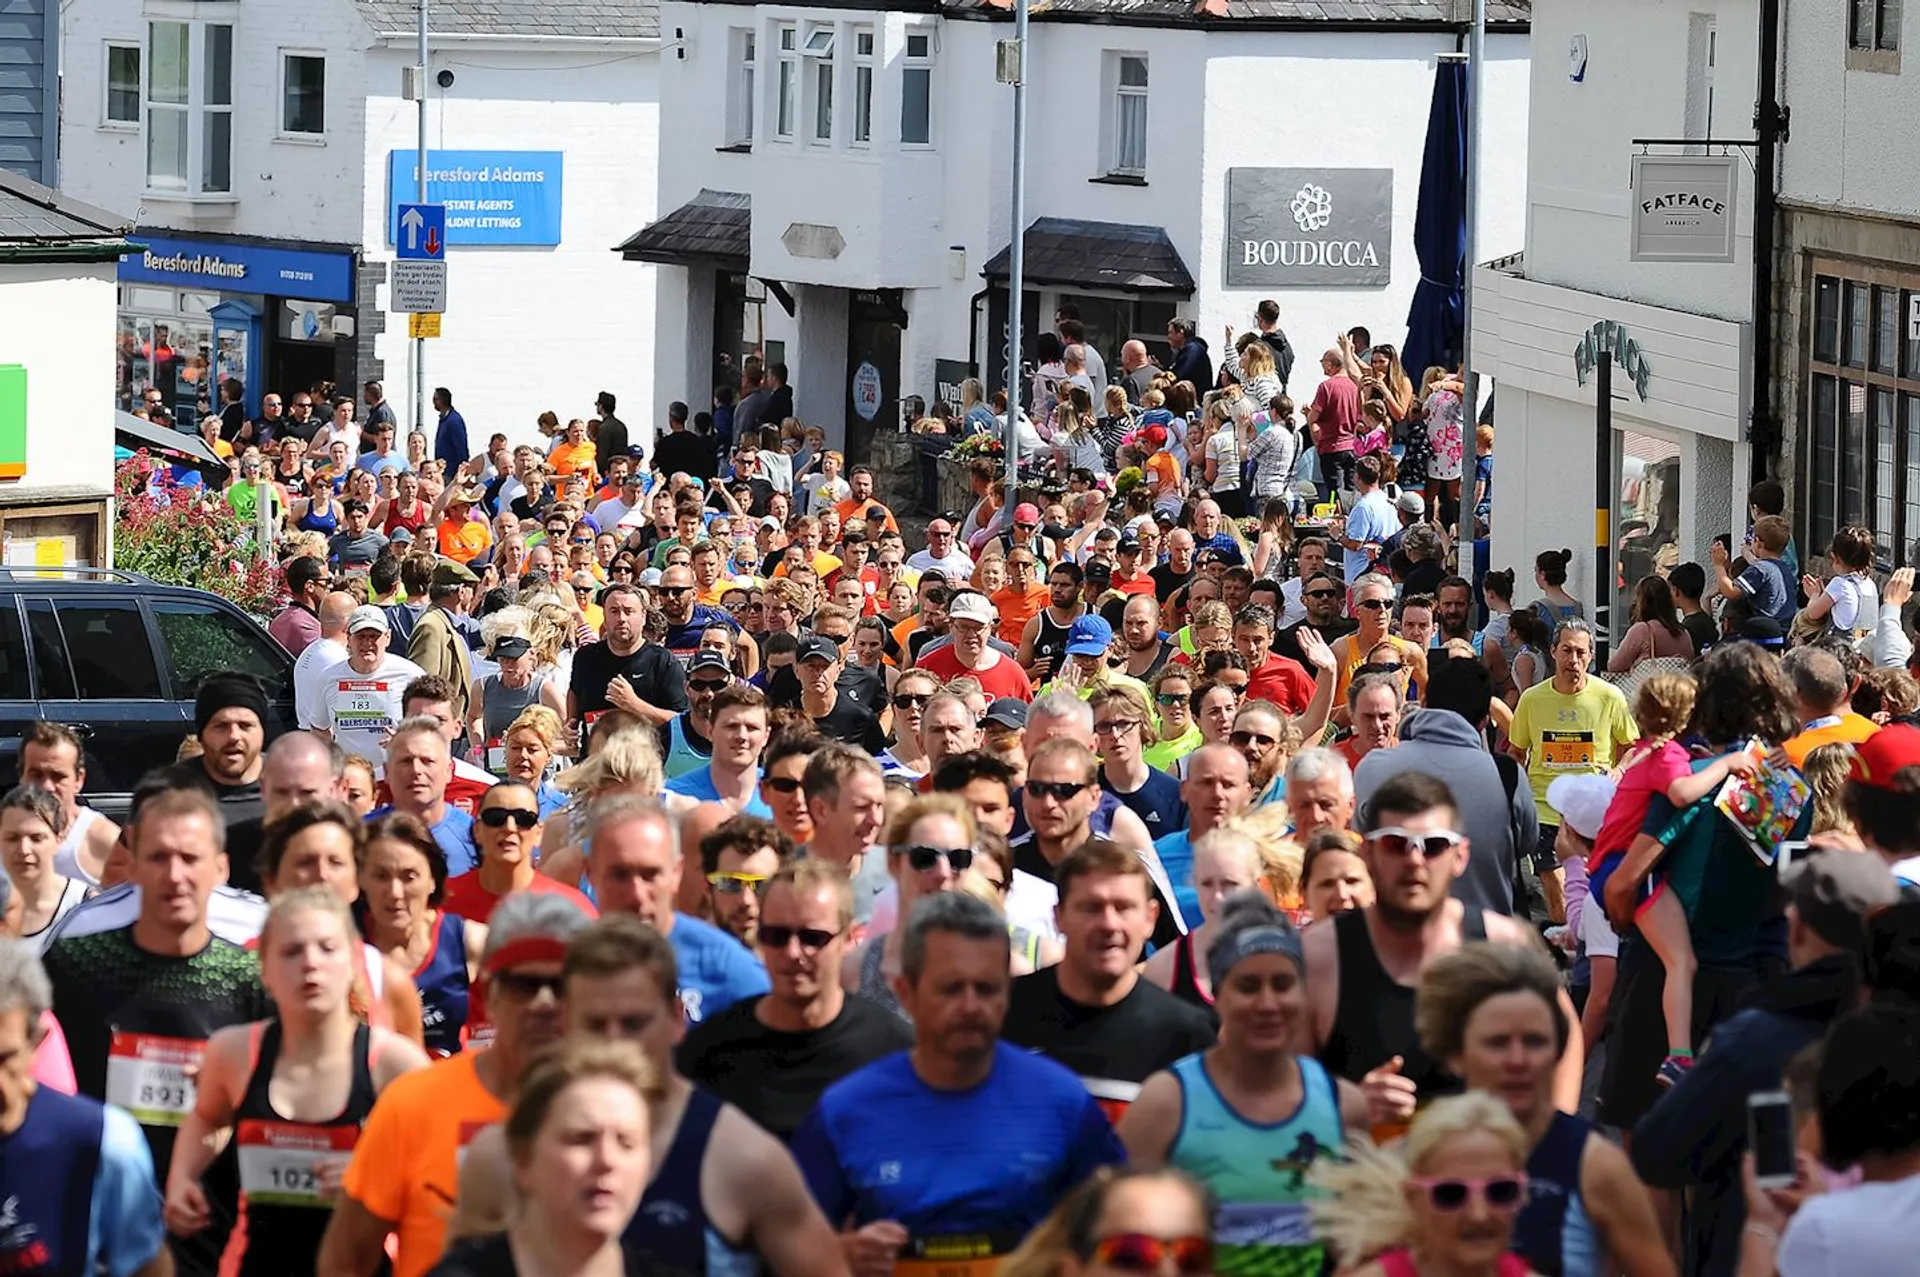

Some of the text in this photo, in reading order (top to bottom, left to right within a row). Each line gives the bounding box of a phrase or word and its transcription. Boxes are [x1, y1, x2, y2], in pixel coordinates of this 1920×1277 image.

[414, 166, 544, 182] eresford Adams
[477, 200, 514, 210] AGENTS
[1642, 193, 1725, 215] FATFACE
[478, 217, 522, 228] LETTINGS
[1242, 240, 1379, 267] BOUDICCA
[143, 250, 246, 278] Beresford Adams
[352, 701, 370, 709] 183
[139, 1083, 185, 1107] 893
